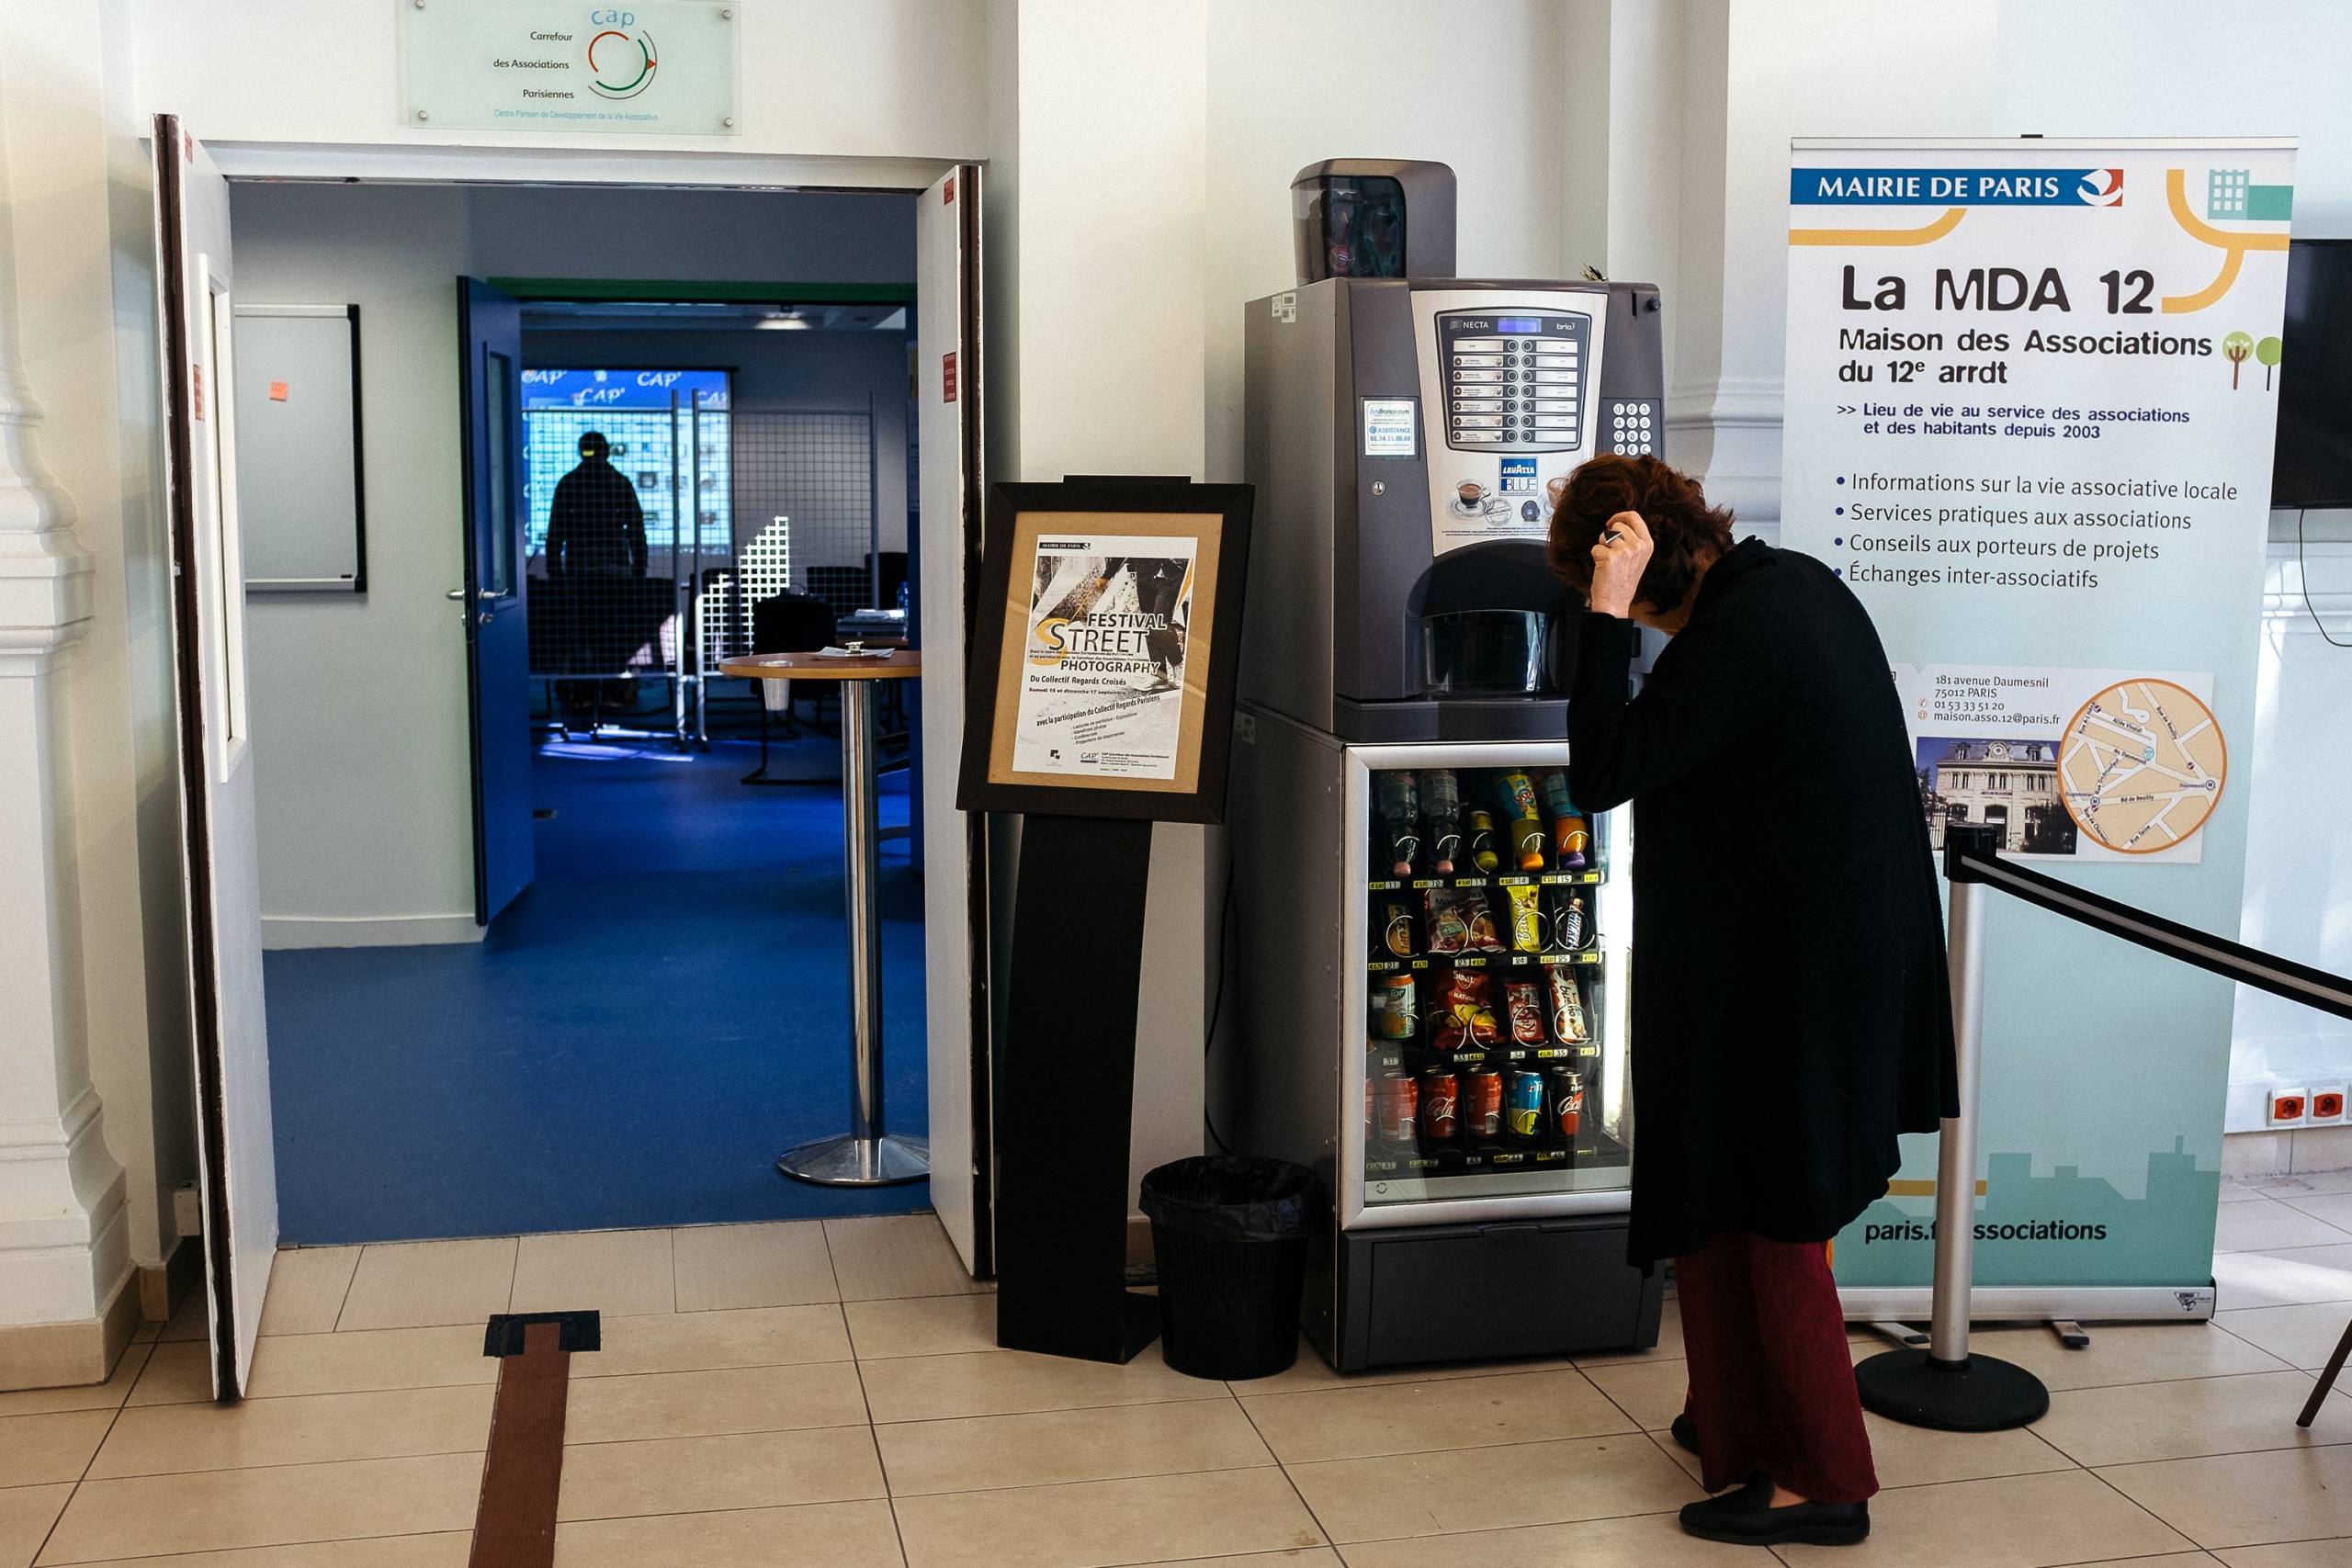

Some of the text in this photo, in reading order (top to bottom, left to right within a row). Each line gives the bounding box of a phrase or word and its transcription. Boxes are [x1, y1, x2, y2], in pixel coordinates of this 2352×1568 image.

[591, 9, 635, 28] cap
[530, 31, 572, 41] Carrefour
[493, 59, 569, 69] des Associations
[523, 89, 574, 99] Parisiennes
[1818, 176, 2059, 198] MAIRIE DE PARIS
[1842, 265, 2154, 314] La MDA 12
[1840, 329, 2212, 356] Maison des Associations
[1839, 360, 1872, 382] du
[1939, 362, 2007, 384] arrdt
[1863, 403, 1896, 417] Lieu
[1904, 404, 1923, 417] de
[1931, 404, 1953, 418] vie
[1962, 406, 1980, 418] au
[1988, 406, 2045, 420] service
[2052, 406, 2080, 421] des
[2088, 408, 2189, 423] associations
[1863, 421, 2100, 440] et des habitants depuis 2003
[1503, 465, 1534, 474] LAVAZZA
[1506, 478, 1536, 491] BLUE
[1852, 474, 2238, 500] Informations sur la vie associative locale
[1851, 504, 2191, 530] Services pratiques aux associations
[1850, 534, 2159, 563] Conseils aux porteurs de projets
[1849, 560, 2098, 589] Échanges inter-associatifs
[1088, 614, 1166, 628] FESTIVAL
[1049, 623, 1149, 653] STREET
[1061, 660, 1160, 673] PHOTOGRAPHY
[1072, 677, 1099, 685] Regards
[1936, 675, 2049, 688] 181 avenue Daumesnil
[1935, 688, 1997, 698] 75012 PARIS
[1054, 710, 1086, 724] participation
[1094, 704, 1115, 714] Collectif
[1116, 700, 1136, 710] Regards
[1137, 695, 1160, 705] Parisiens
[1948, 701, 1960, 711] 53
[1962, 702, 1975, 711] 33
[1978, 703, 1989, 711] 51
[1934, 712, 2060, 725] maison.asso.12@paris.fr
[1560, 986, 1576, 1017] bueno
[1426, 1096, 1456, 1117] Cola
[1865, 1219, 2107, 1246] paris.fssociations
